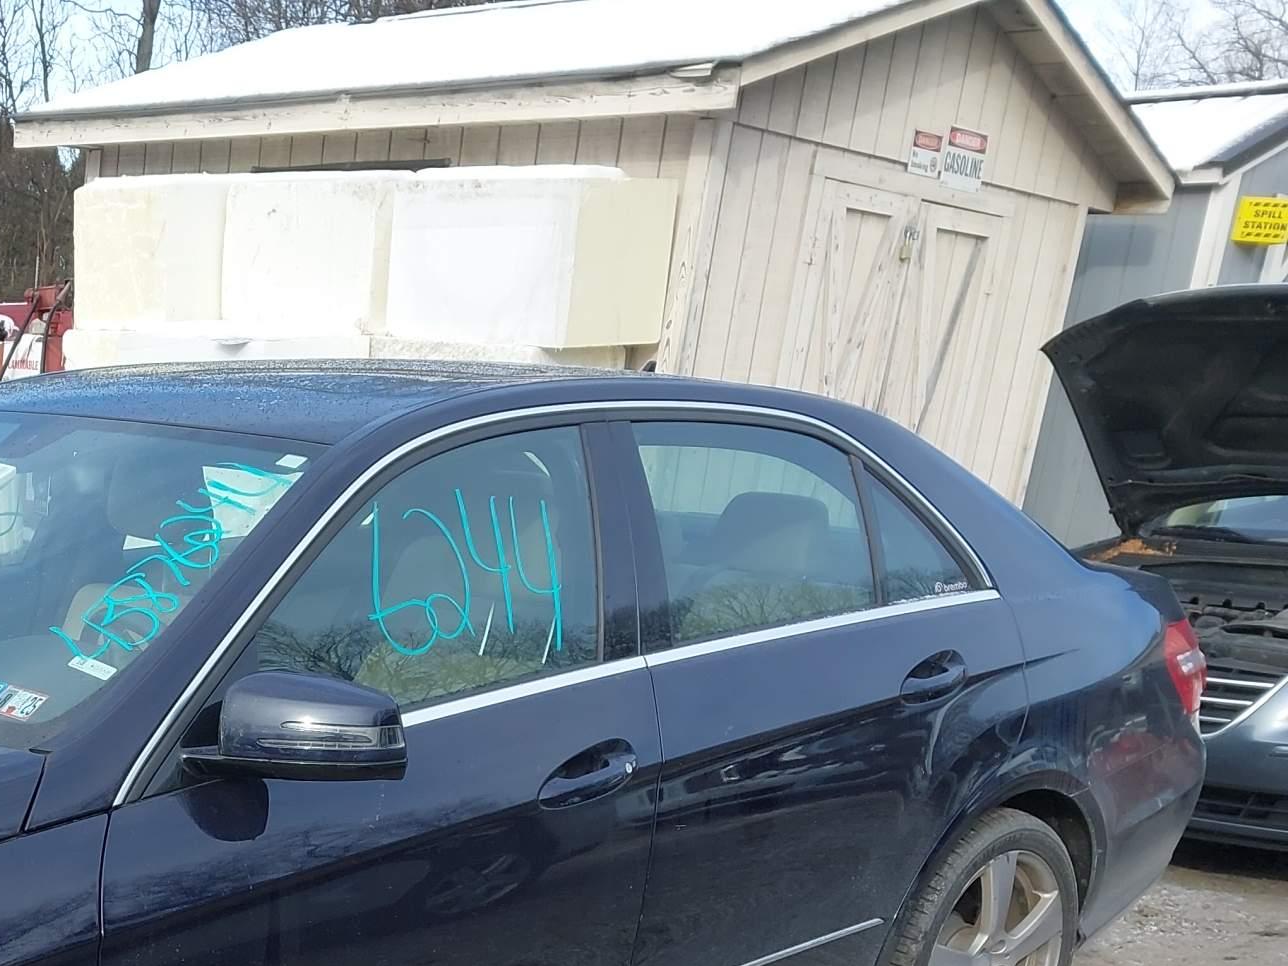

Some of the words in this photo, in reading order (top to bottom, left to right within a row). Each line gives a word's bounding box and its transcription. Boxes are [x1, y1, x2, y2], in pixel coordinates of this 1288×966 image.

[943, 150, 985, 179] GASOLINE
[1253, 209, 1283, 219] SPILL
[1243, 220, 1288, 231] STATION
[367, 488, 563, 657] 6244
